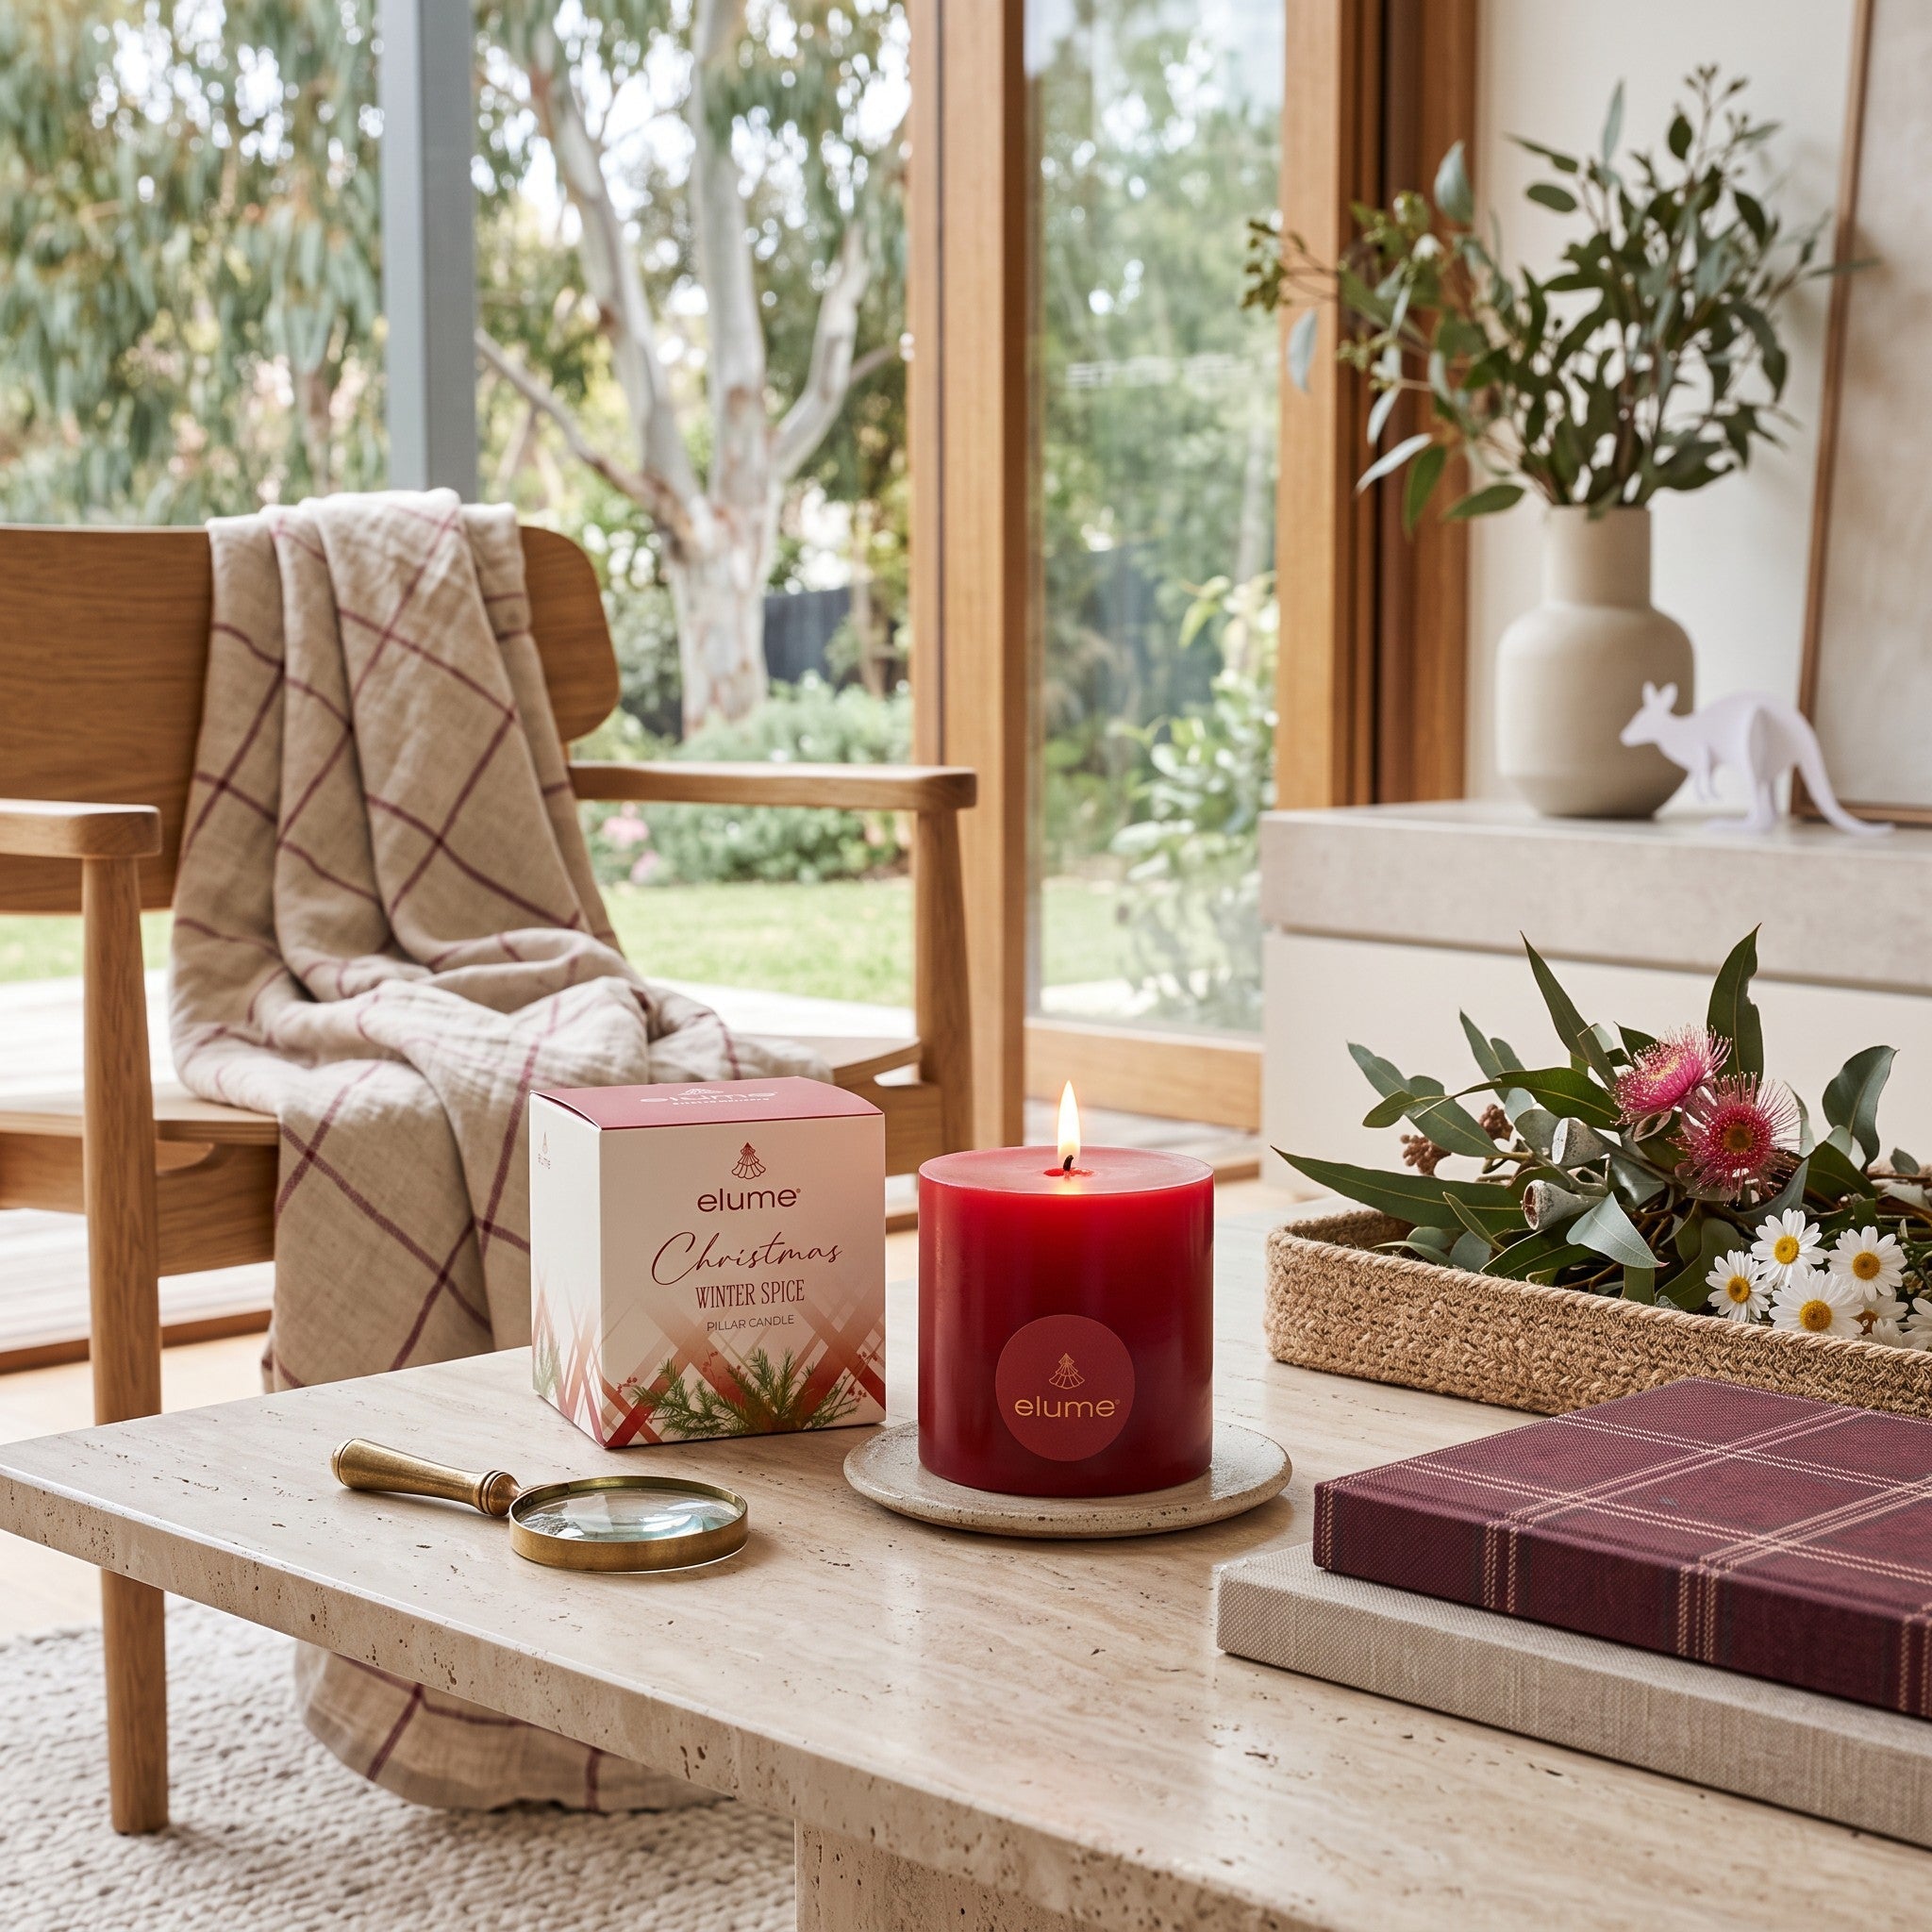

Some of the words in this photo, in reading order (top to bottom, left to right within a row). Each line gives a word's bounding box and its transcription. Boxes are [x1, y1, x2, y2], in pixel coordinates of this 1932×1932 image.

[697, 1188, 798, 1212] elume
[651, 1231, 843, 1286] Christmas
[695, 1283, 757, 1309] WINTER
[761, 1279, 805, 1305] SPICE
[707, 1319, 746, 1332] PILLAR
[748, 1314, 795, 1328] CANDLE
[1014, 1395, 1116, 1418] elume
